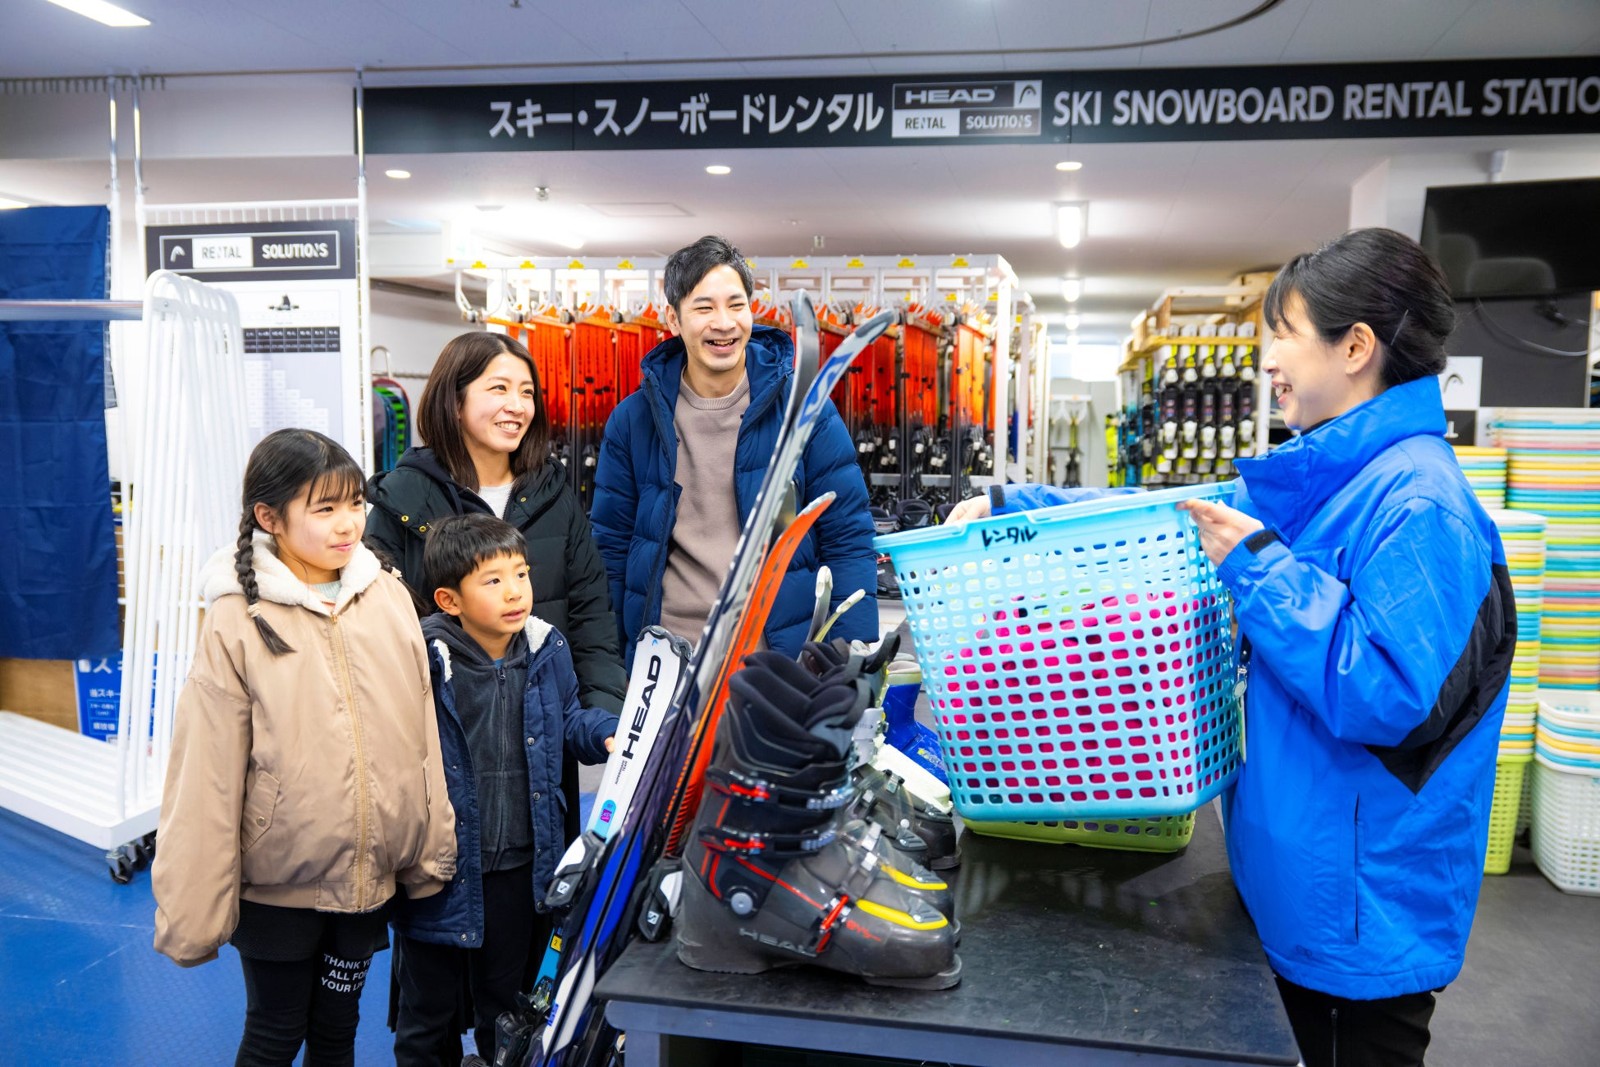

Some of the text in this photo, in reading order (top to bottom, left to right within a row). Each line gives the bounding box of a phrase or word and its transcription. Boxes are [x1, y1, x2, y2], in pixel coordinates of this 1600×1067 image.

[905, 88, 996, 105] HEAD
[1052, 90, 1102, 127] SKI
[1112, 85, 1334, 126] SNOWBOARD
[1343, 80, 1472, 120] RENTAL
[489, 92, 885, 138] スキー・スノーボードレンタル
[905, 114, 1032, 130] RENTAL SOLUTIONS
[202, 243, 329, 260] RENTAL SOLUTIONS
[981, 525, 1038, 551] レンタル
[621, 654, 662, 760] HEAD
[324, 954, 361, 969] THANK
[328, 970, 350, 980] ALL
[322, 976, 352, 992] YOUR
